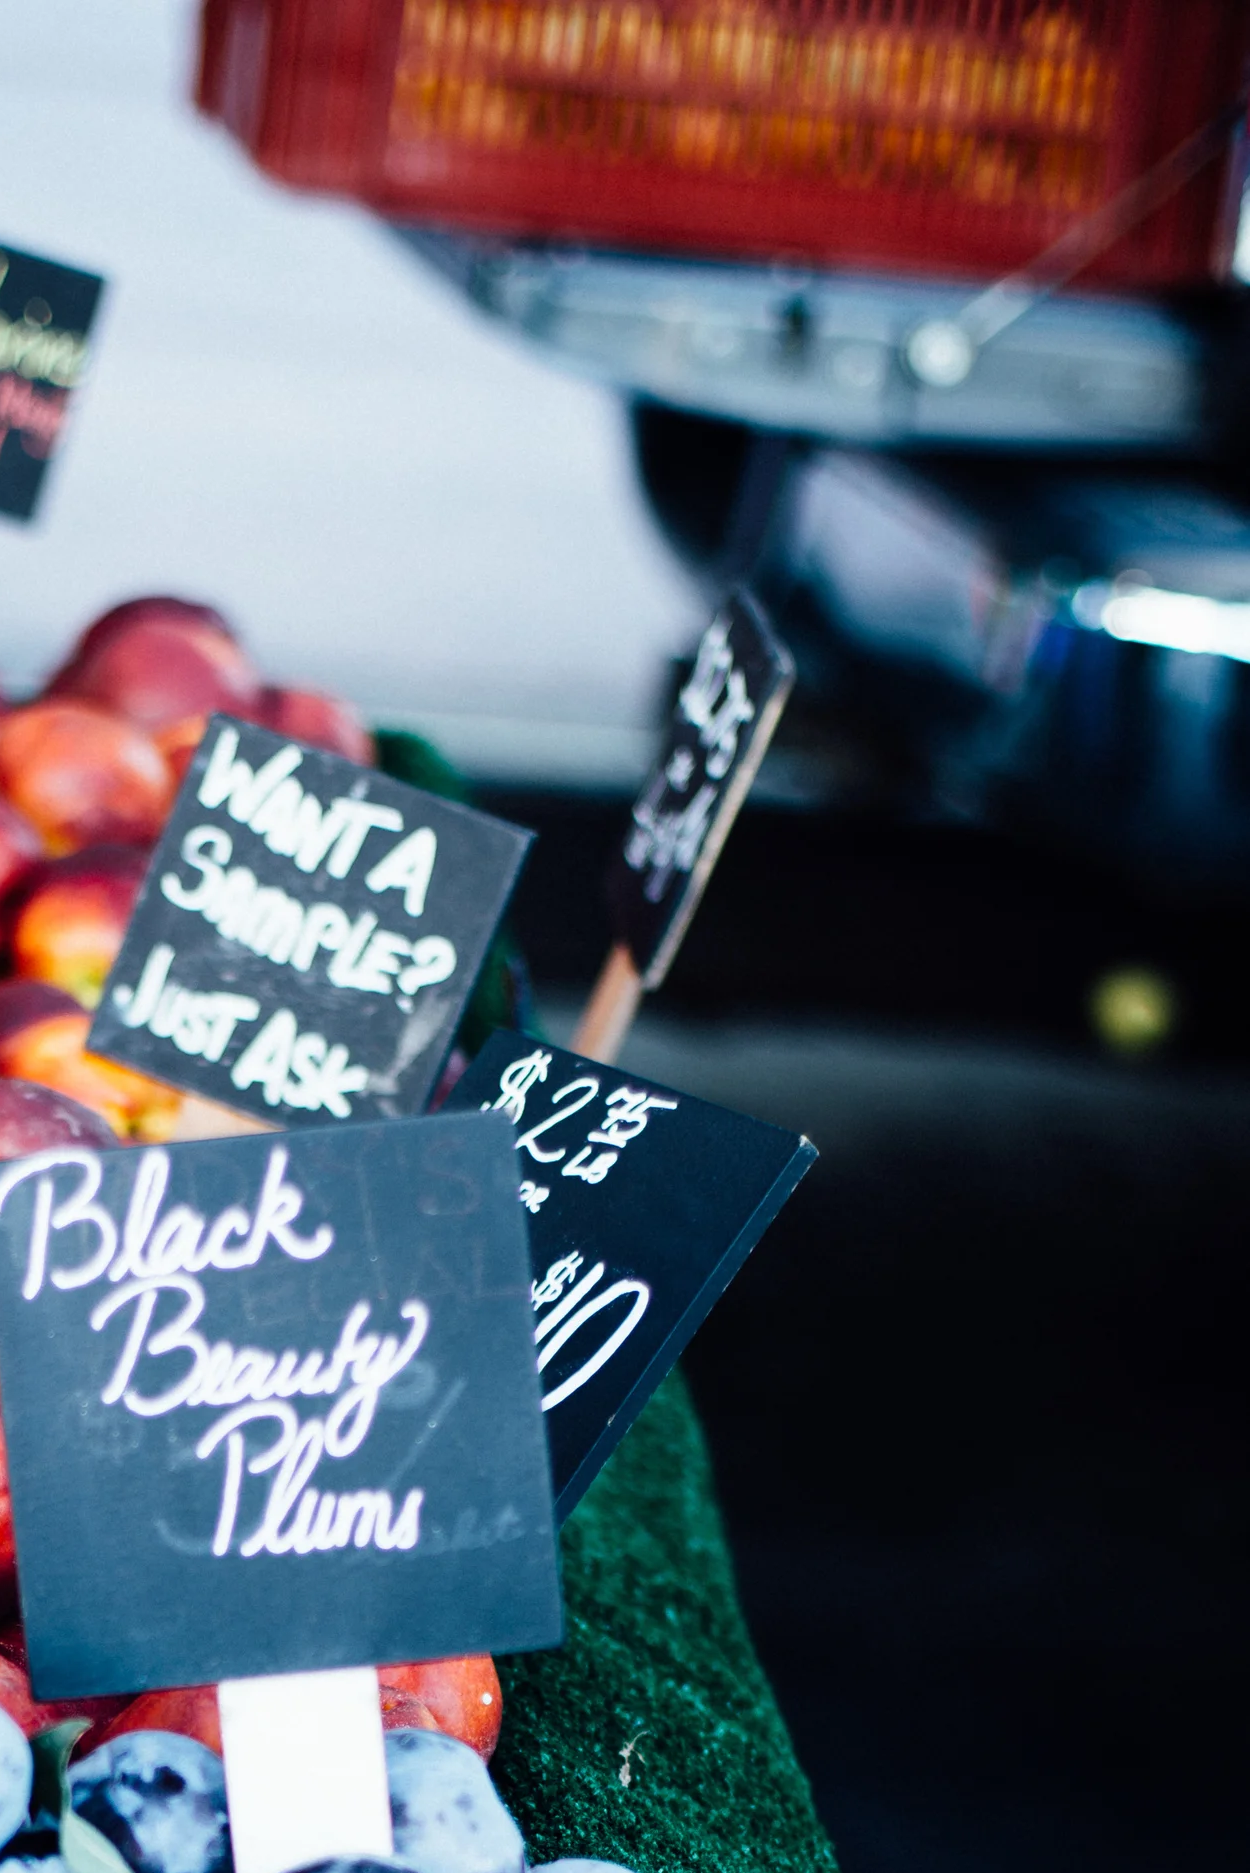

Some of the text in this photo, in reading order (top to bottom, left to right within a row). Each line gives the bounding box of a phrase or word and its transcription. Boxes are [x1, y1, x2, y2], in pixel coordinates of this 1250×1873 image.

[197, 726, 437, 917] WANT A
[112, 943, 369, 1119] JUST ASK
[91, 1273, 429, 1458] Beauty
[196, 1401, 425, 1557] Plums
